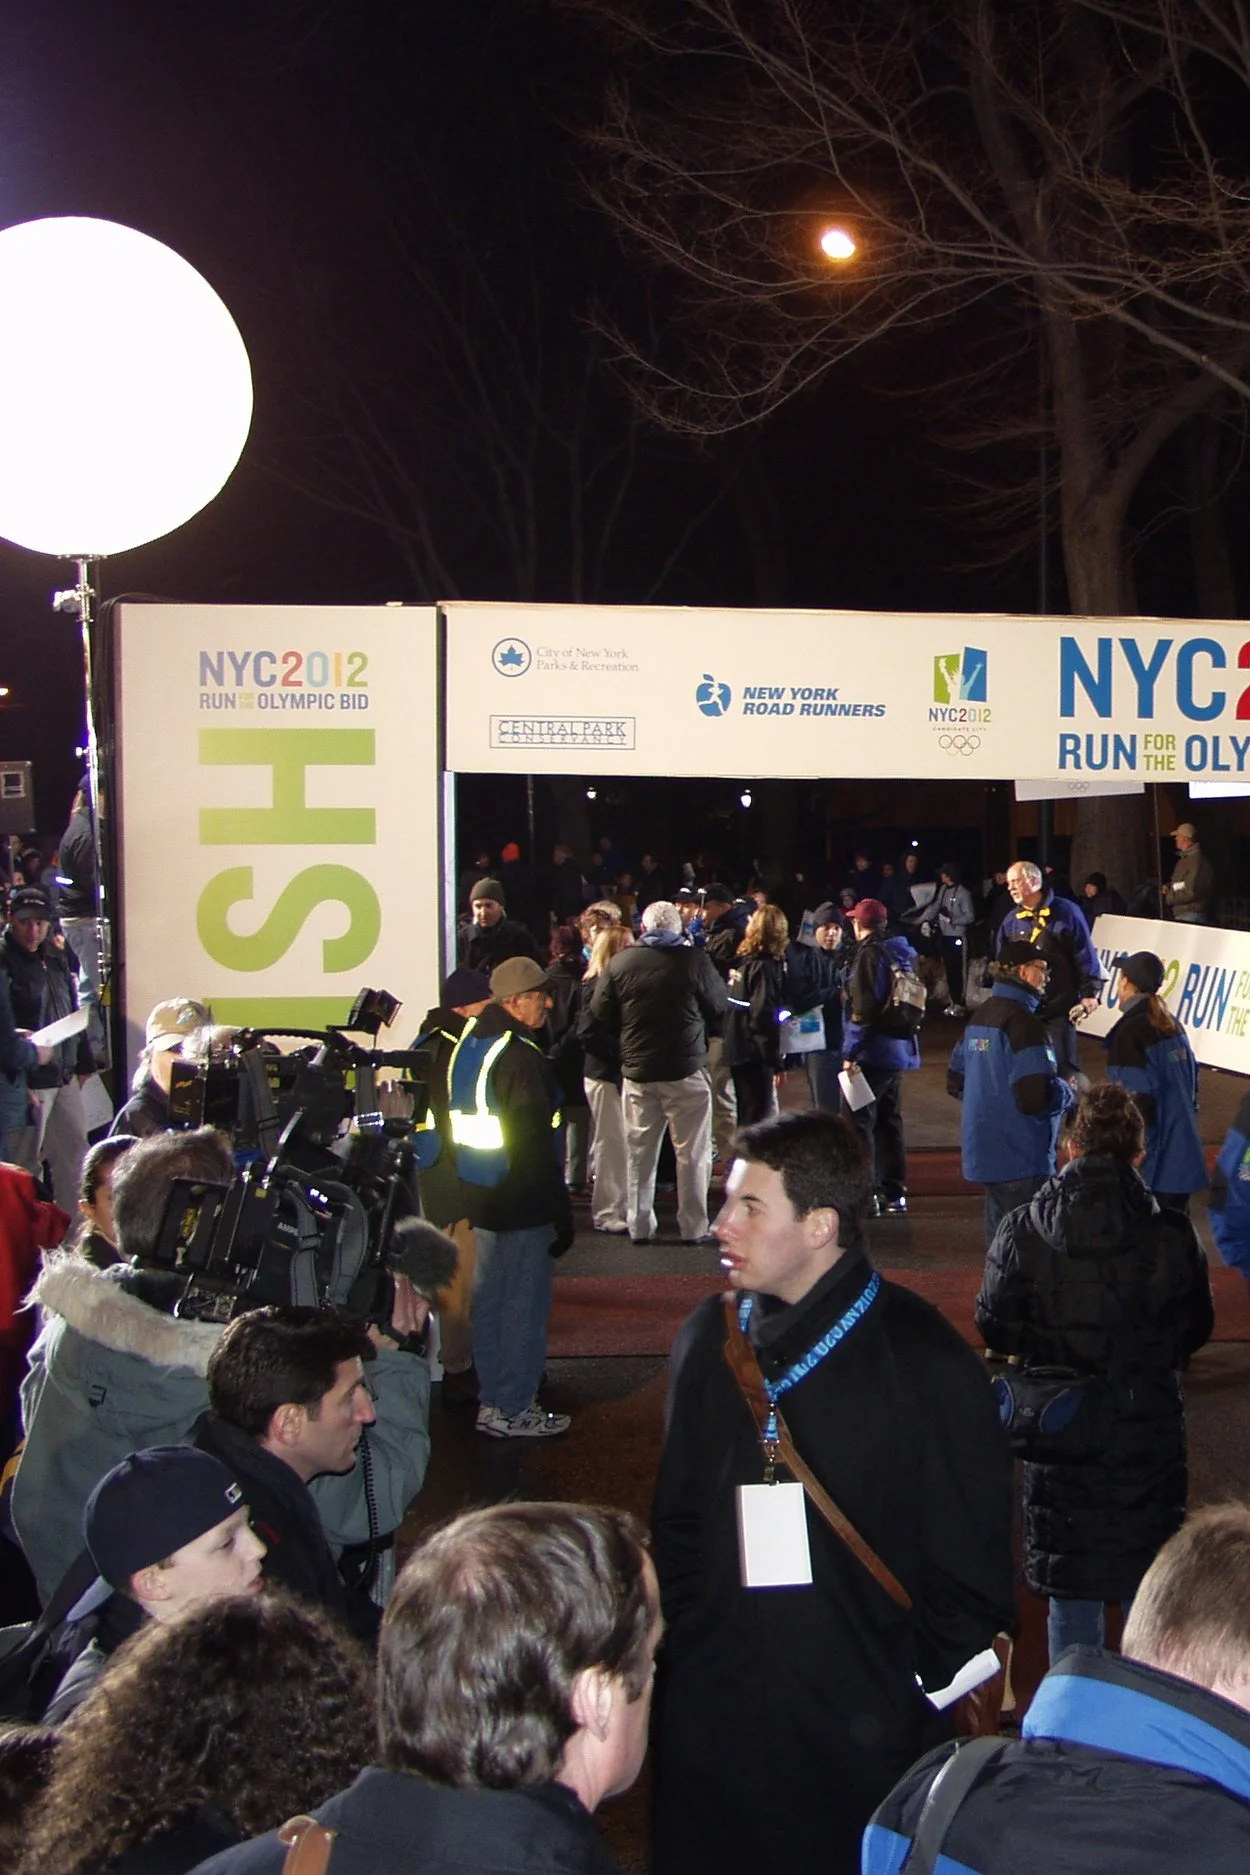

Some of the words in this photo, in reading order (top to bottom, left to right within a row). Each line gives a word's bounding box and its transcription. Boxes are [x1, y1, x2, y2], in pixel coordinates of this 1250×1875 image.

[536, 646, 559, 659] City
[562, 646, 573, 658] of
[576, 648, 600, 658] New
[603, 648, 628, 659] York
[199, 650, 369, 688] NYC2012
[536, 660, 567, 671] Parks
[569, 660, 578, 671] &
[581, 661, 640, 672] Recreation
[199, 693, 236, 709] RUN
[257, 693, 335, 710] OLYMPIC
[340, 693, 369, 710] BID
[742, 686, 786, 700] NEW
[791, 687, 840, 701] YORK
[742, 702, 795, 716] ROAD
[799, 703, 886, 717] RUNNERS
[929, 707, 991, 723] NYC2012
[498, 720, 577, 735] CENTRAL
[583, 721, 626, 736] PARK
[1144, 734, 1176, 751] FOR
[1058, 733, 1137, 771] RUN
[1144, 754, 1176, 771] THE
[1175, 963, 1237, 1032] RUN
[277, 1221, 300, 1238] AMPE
